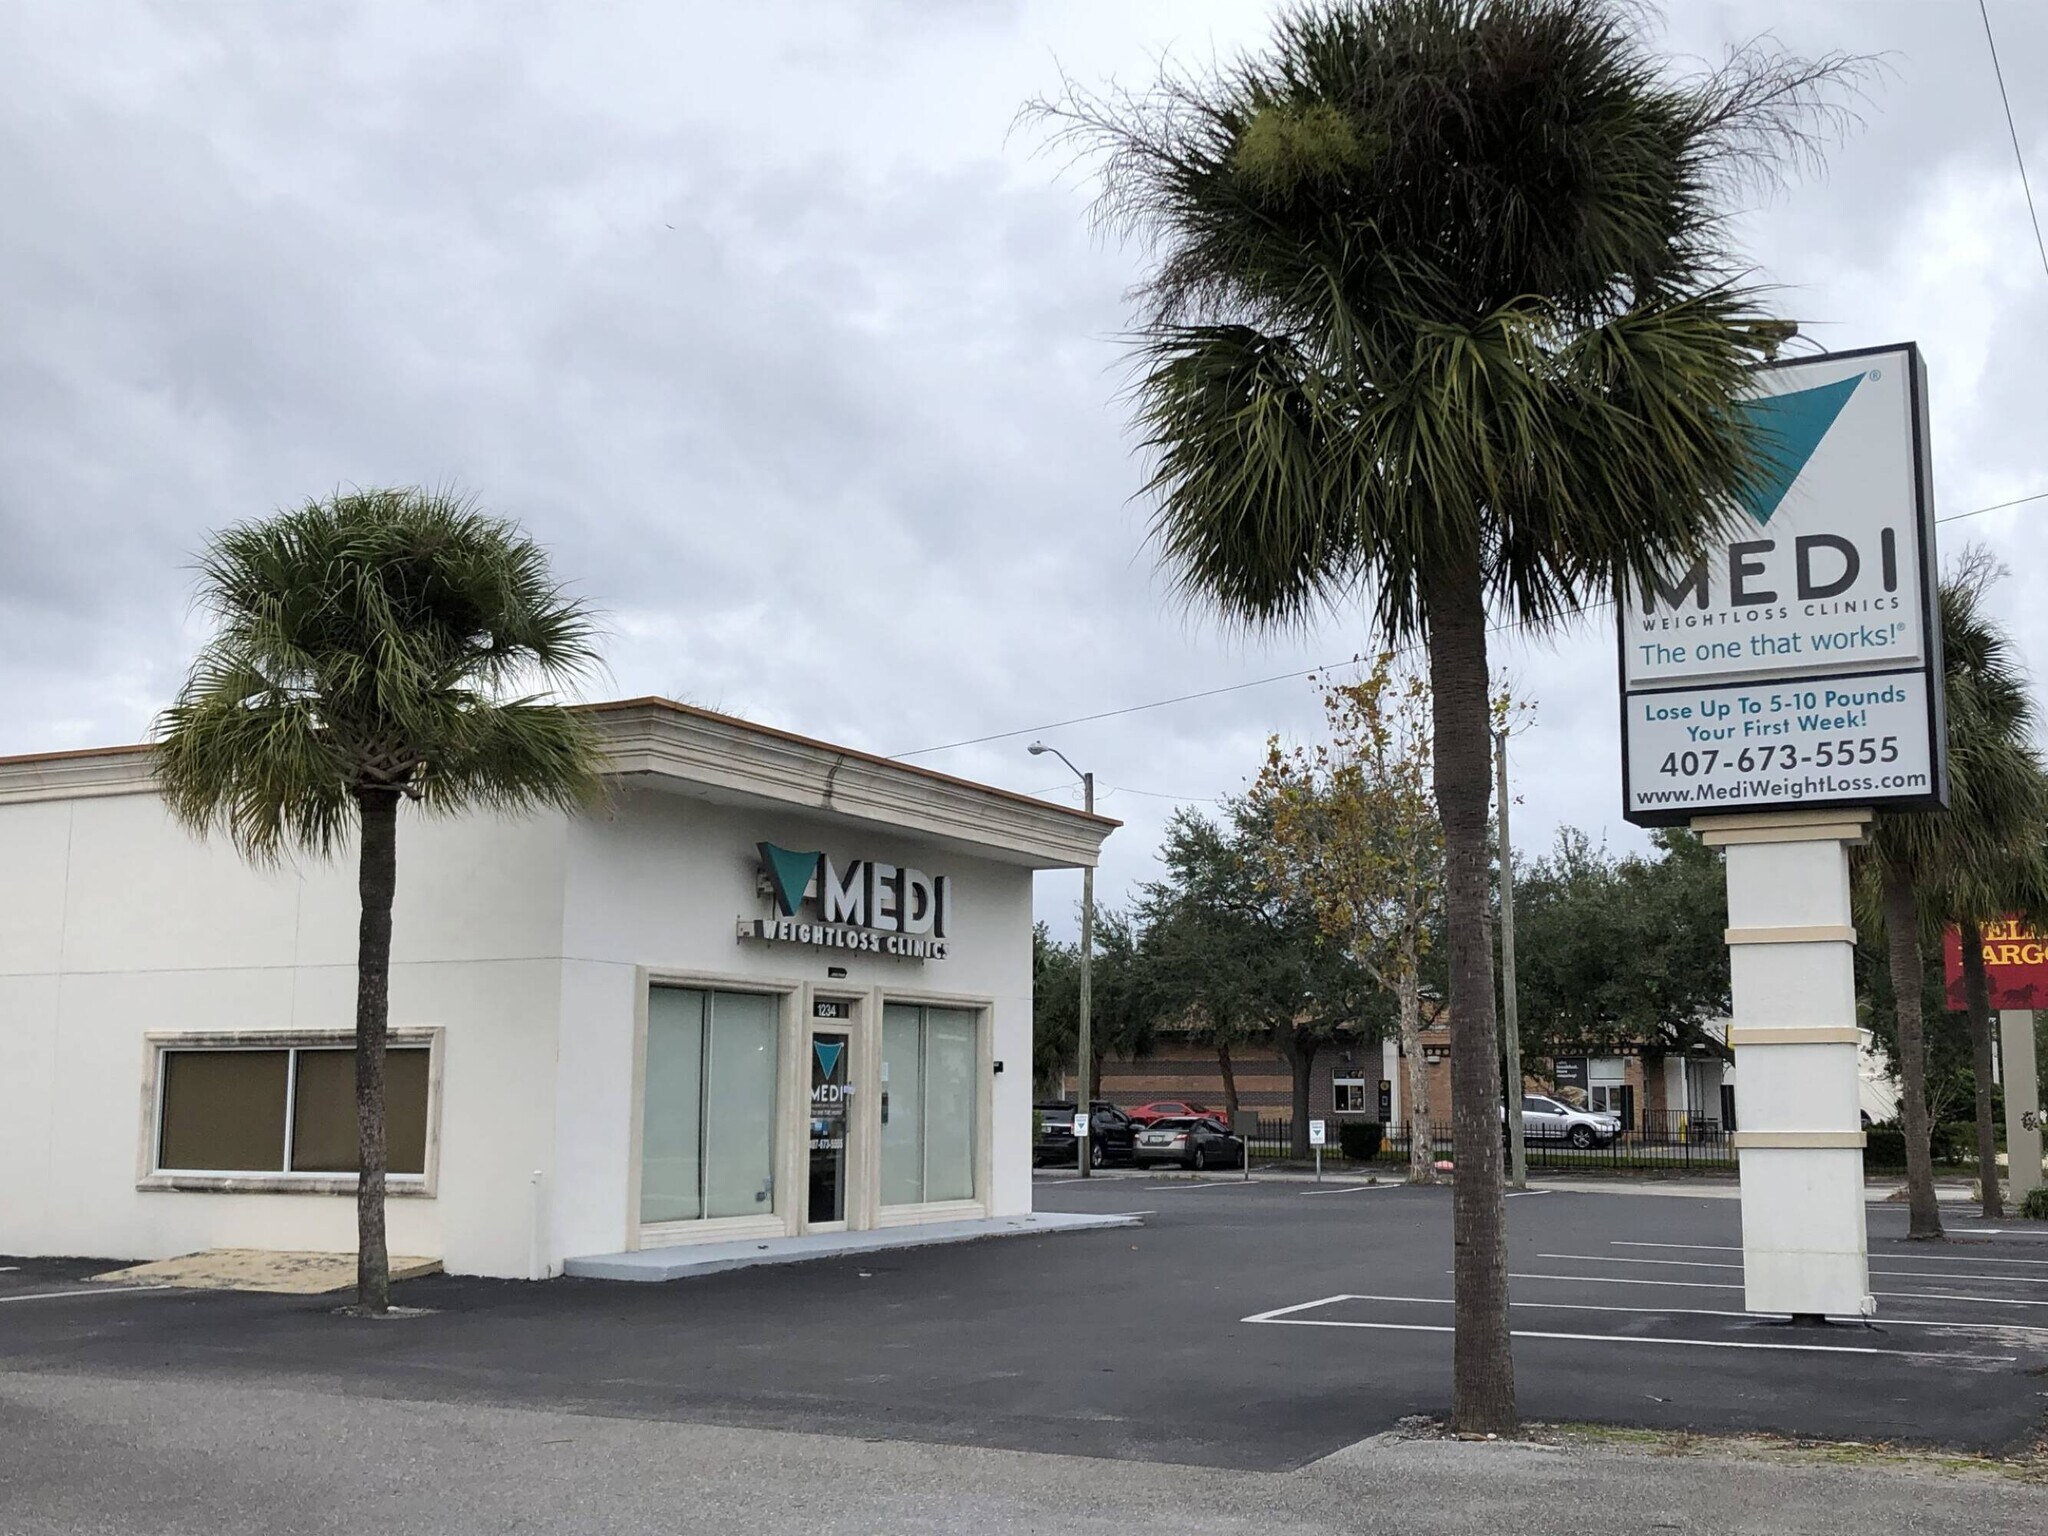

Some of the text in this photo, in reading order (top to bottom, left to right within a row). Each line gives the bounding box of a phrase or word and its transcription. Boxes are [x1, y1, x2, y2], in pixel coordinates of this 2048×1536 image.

[1643, 596, 1899, 631] WEIGHTLOSS CLINICS
[1639, 643, 1686, 665] The
[1696, 641, 1741, 661] one
[1750, 632, 1802, 656] that
[1645, 684, 1906, 721] Lose Up To 5-10 Pounds
[1686, 709, 1867, 742] Your First Week!
[1660, 736, 1899, 778] 407-673-5555
[1637, 772, 1927, 804] www.MediWeightLoss.com
[819, 853, 949, 938] MEDI
[760, 919, 949, 960] WEIGHTLOSS CLINICS
[1958, 943, 2048, 966] ARG
[818, 1004, 837, 1017] 1234
[810, 1084, 844, 1102] MEDI
